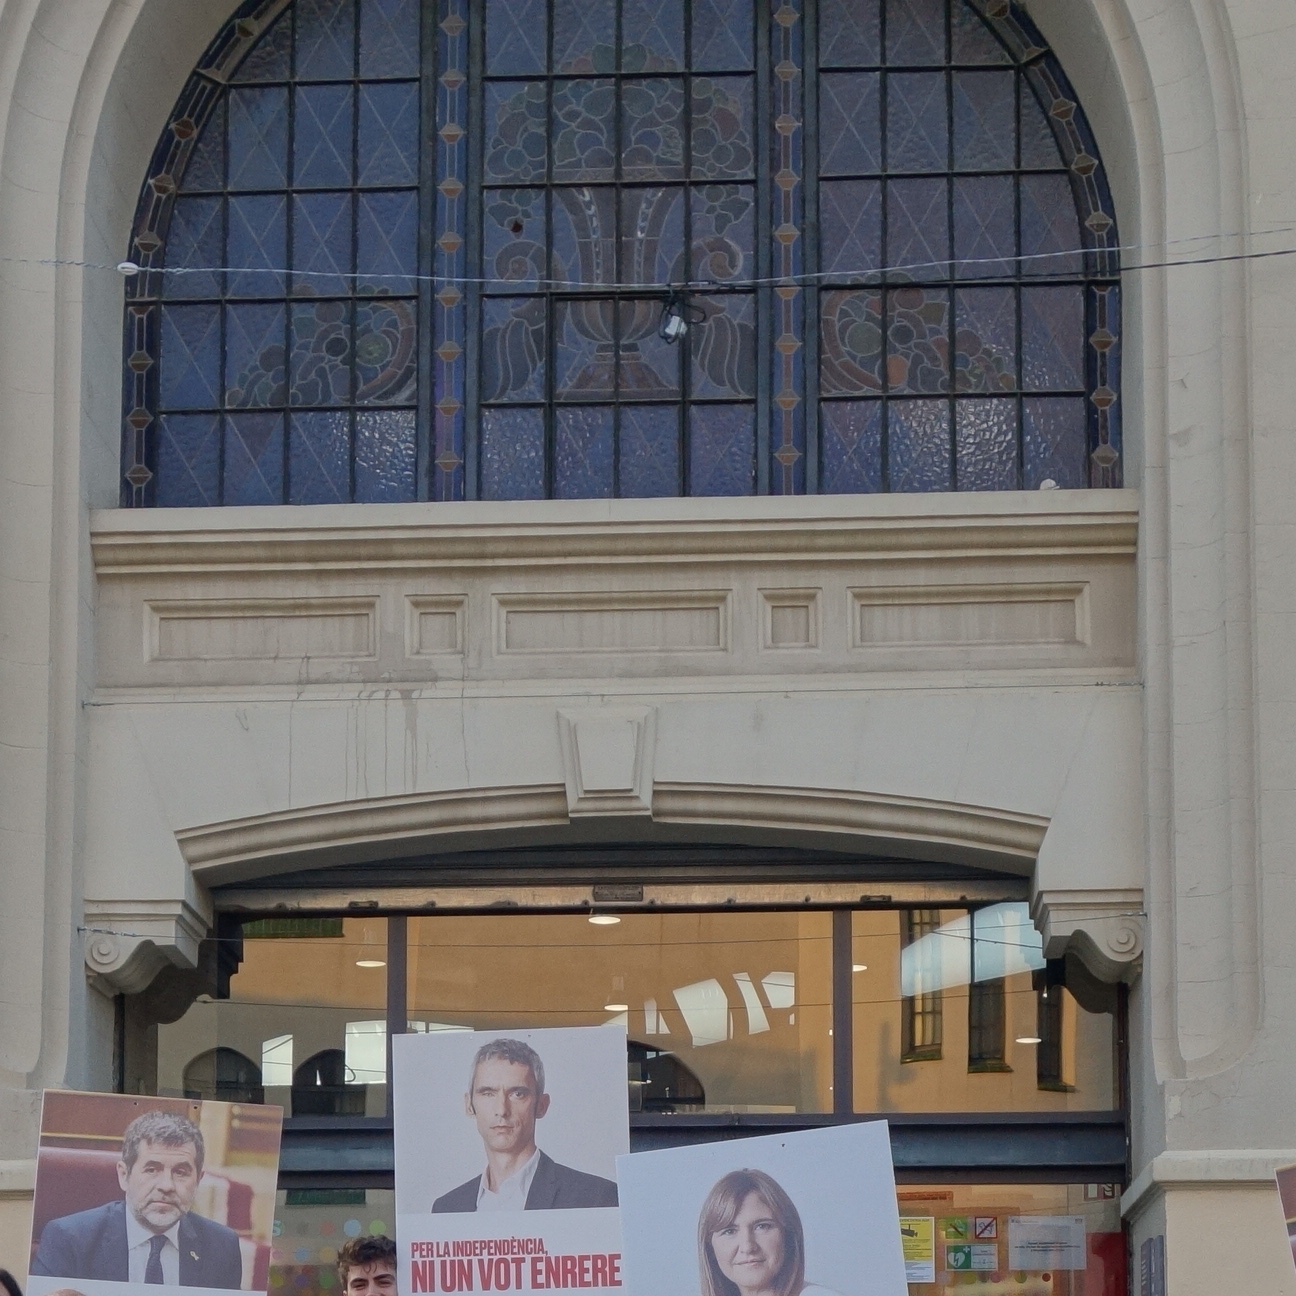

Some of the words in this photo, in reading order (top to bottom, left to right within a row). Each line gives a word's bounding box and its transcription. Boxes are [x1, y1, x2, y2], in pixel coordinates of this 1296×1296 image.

[411, 1242, 434, 1258] PER
[436, 1241, 451, 1258] LA
[453, 1236, 548, 1257] INDEPENDÈNCIA,
[412, 1260, 435, 1293] NI
[440, 1259, 473, 1293] UN
[477, 1257, 526, 1291] VOT
[530, 1253, 622, 1289] ENRERE
